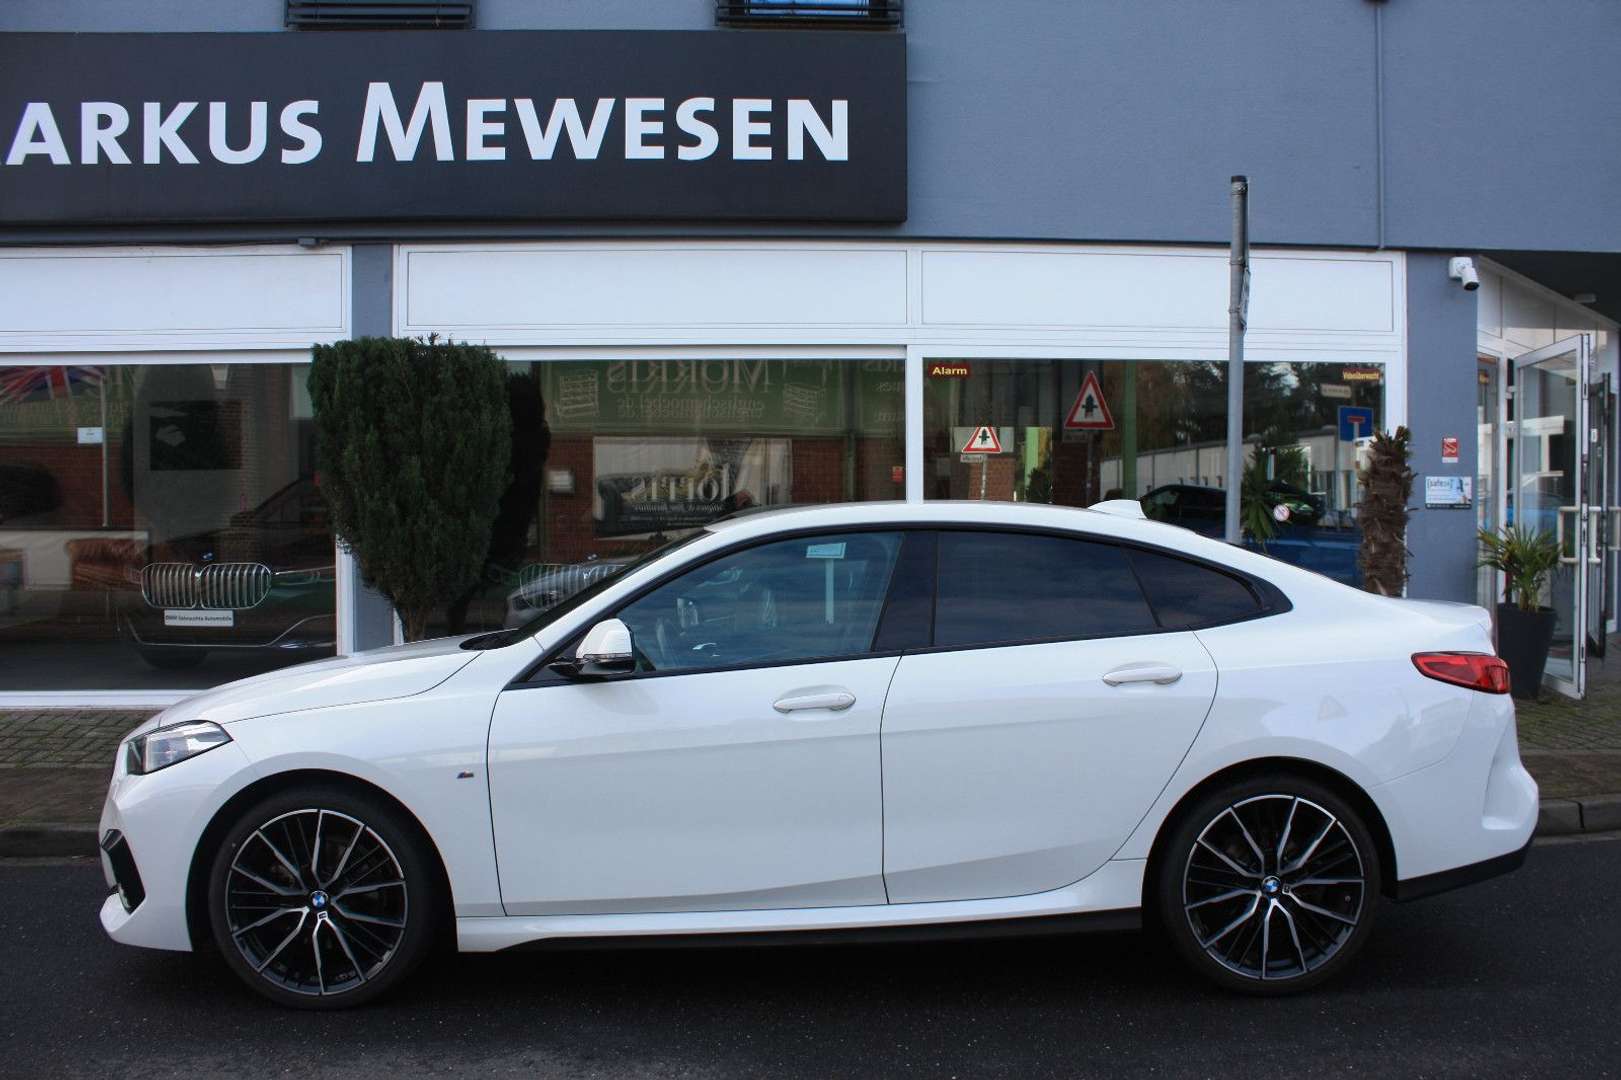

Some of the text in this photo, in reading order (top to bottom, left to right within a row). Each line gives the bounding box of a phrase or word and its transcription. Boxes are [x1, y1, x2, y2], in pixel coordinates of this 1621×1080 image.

[0, 81, 850, 167] ARKUS MEWESEN
[932, 366, 968, 376] Alarm
